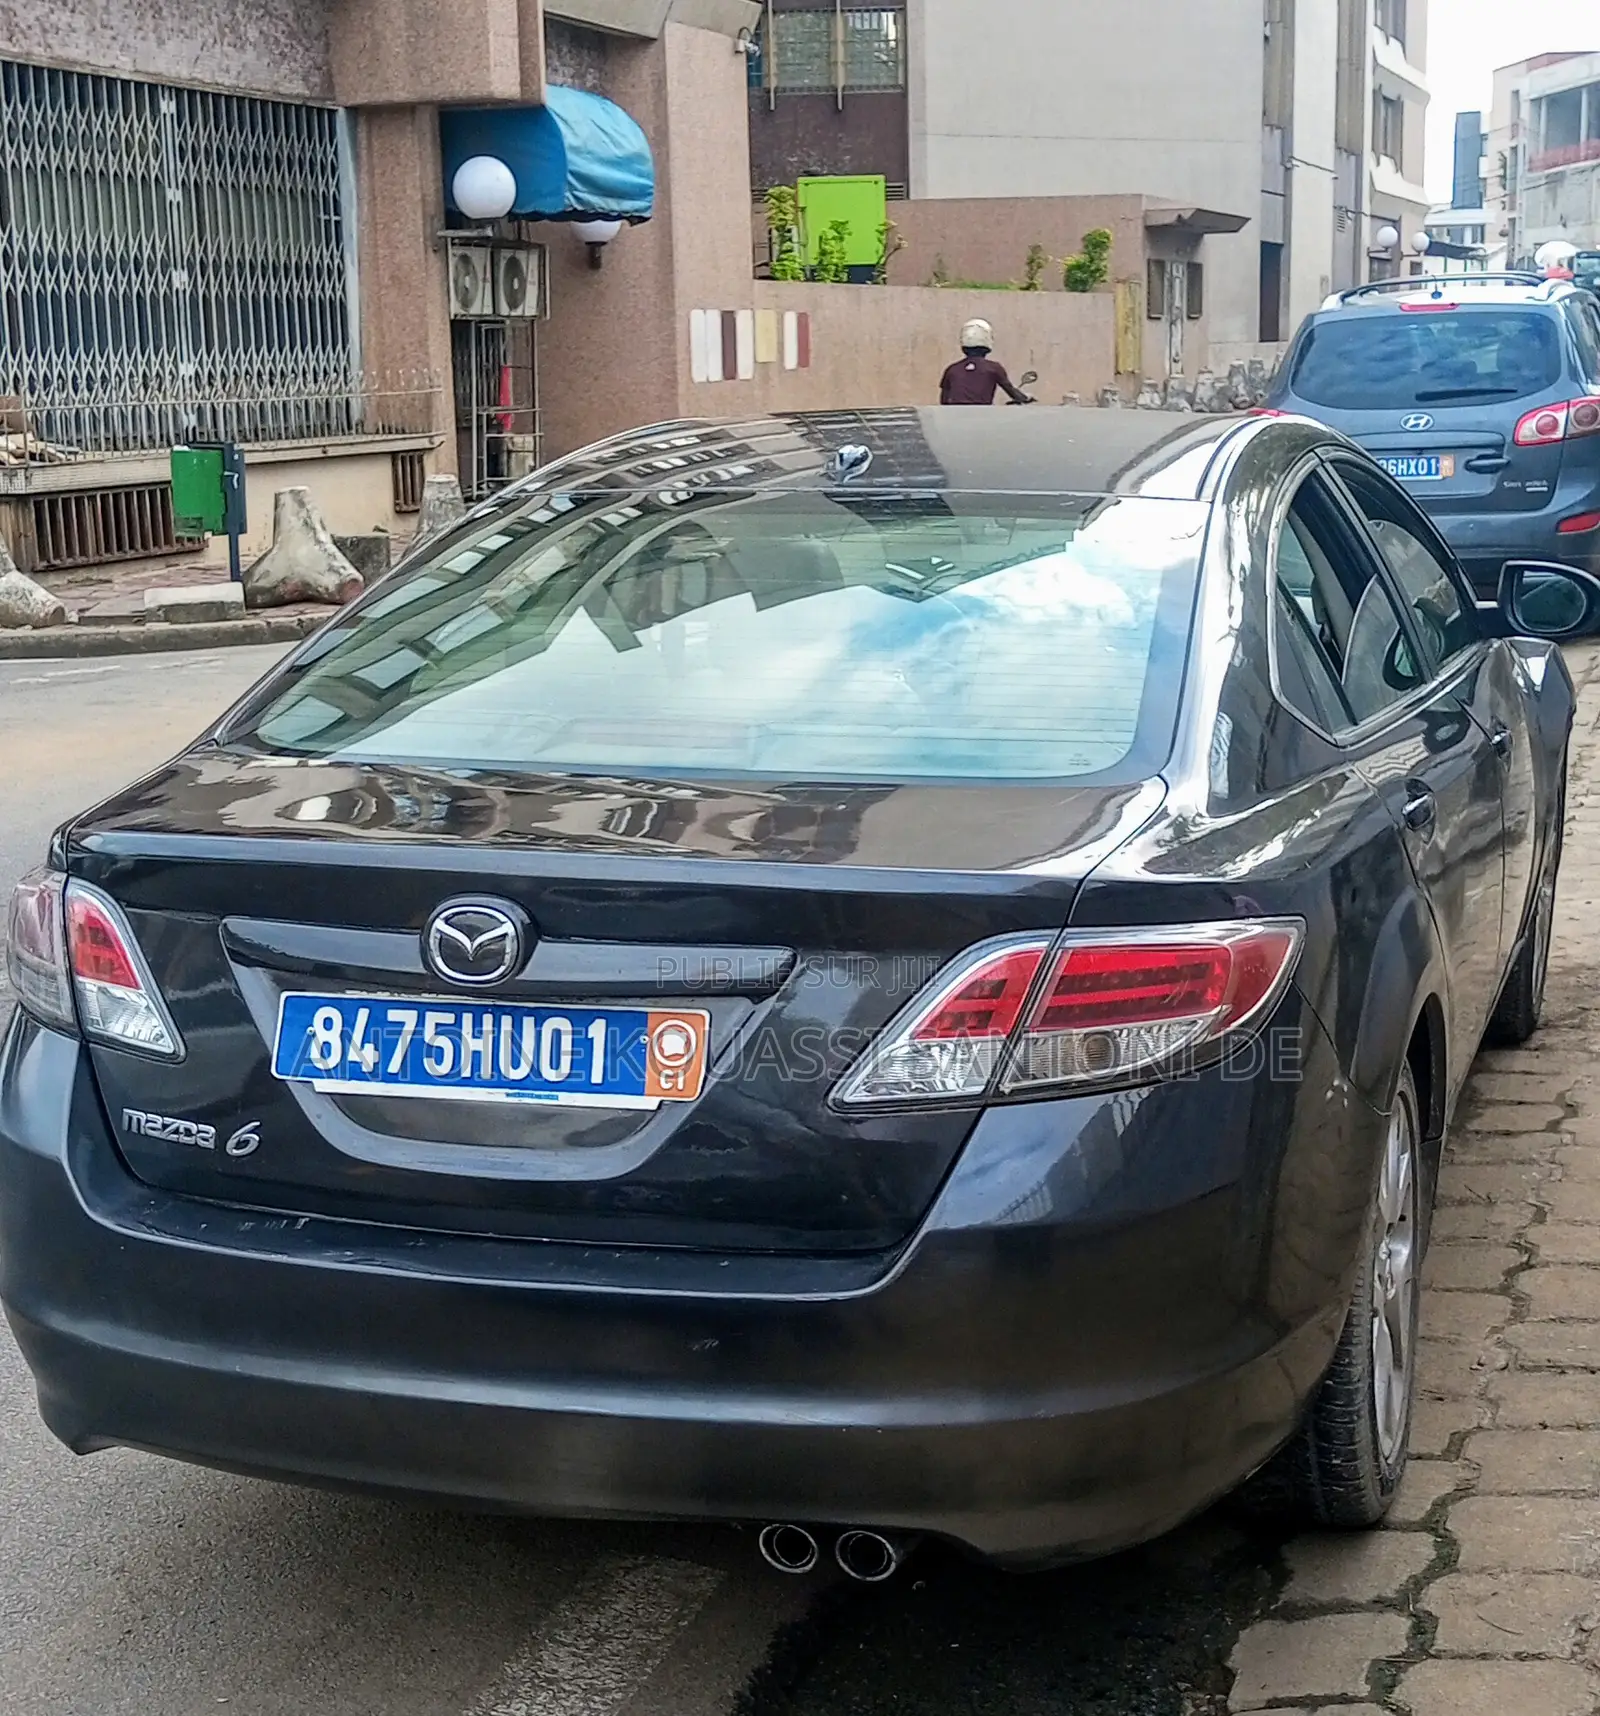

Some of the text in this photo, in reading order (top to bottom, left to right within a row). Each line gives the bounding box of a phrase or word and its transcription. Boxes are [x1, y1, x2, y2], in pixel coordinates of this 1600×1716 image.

[310, 1005, 607, 1084] 8475HU01
[660, 1069, 685, 1091] CI
[226, 1120, 261, 1157] 6
